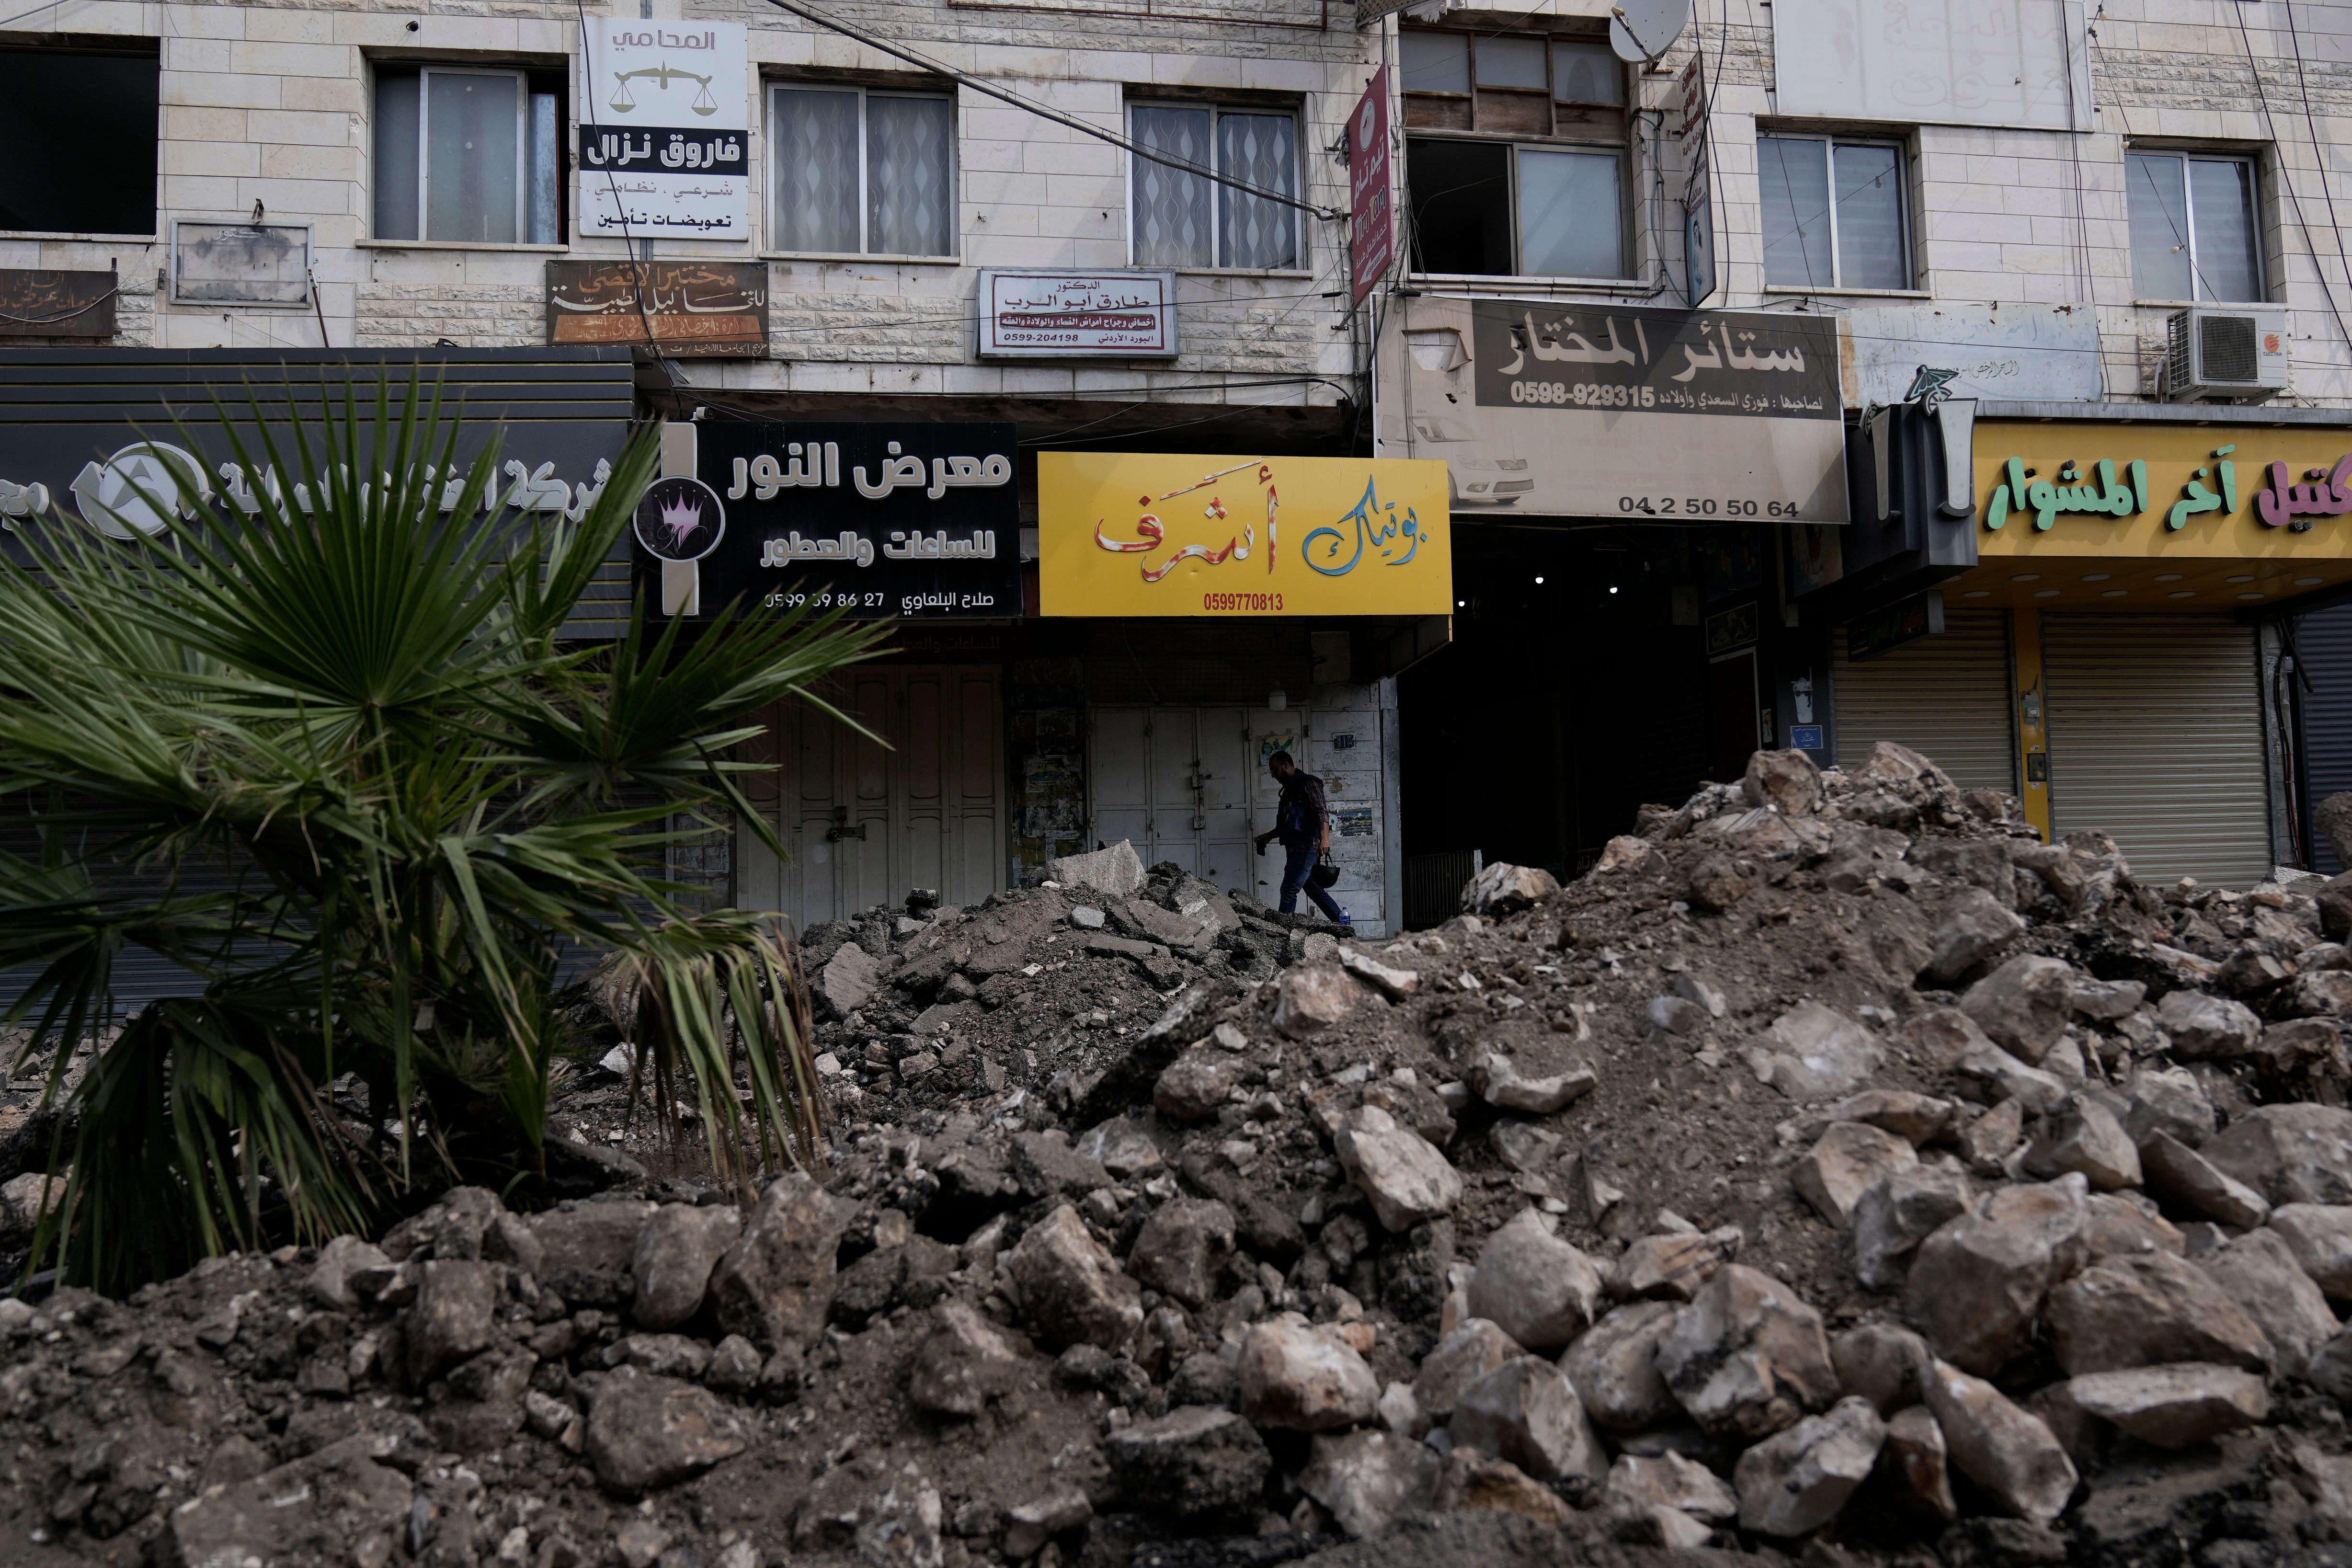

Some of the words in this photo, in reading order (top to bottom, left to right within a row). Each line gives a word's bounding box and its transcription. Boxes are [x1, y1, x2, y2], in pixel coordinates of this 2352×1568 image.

[613, 30, 716, 51] المحامي
[587, 133, 651, 165] نزال
[660, 136, 740, 168] فاروق
[1370, 133, 1384, 186] تيم
[595, 181, 657, 201] نظامي
[674, 181, 733, 203] شرعي
[1354, 158, 1370, 209] تام
[598, 208, 648, 229] تأمين
[652, 214, 732, 231] تعويضات
[213, 226, 276, 241] الكتور
[1055, 280, 1100, 292] الدكتور
[1005, 293, 1057, 310] الرب
[1061, 291, 1092, 310] أبو
[1096, 294, 1150, 310] طارق
[1027, 316, 1054, 327] والولادة
[1056, 317, 1078, 326] النساء
[1004, 333, 1078, 342] 0599-204198
[1130, 334, 1153, 343] البورد
[1497, 310, 1650, 375] المختار
[1671, 315, 1805, 382] ستائر
[1510, 381, 1656, 409] 0598-929315
[1659, 386, 1695, 408] وأولاده
[1698, 391, 1739, 410] السعدي
[1741, 391, 1769, 412] فوزي
[1780, 394, 1823, 412] لصاحبها
[728, 442, 840, 501] النور
[853, 441, 1012, 500] معرض
[1983, 456, 2148, 532] المشوار
[2165, 444, 2237, 532] آخر
[1619, 496, 1651, 513] 04
[1660, 498, 1676, 514] 2
[1685, 499, 1717, 515] 50
[1726, 500, 1758, 516] 50
[1766, 501, 1799, 517] 64
[1095, 460, 1279, 583] أشرف
[1302, 473, 1428, 576] بوتيك
[760, 530, 875, 568] والعطور
[883, 530, 996, 560] للساعات
[837, 593, 857, 607] 86
[864, 593, 884, 607] 27
[902, 592, 956, 615] البلعاوي
[962, 593, 994, 608] صلاح
[1204, 593, 1283, 611] 0599770813
[945, 636, 1000, 650] للساعات
